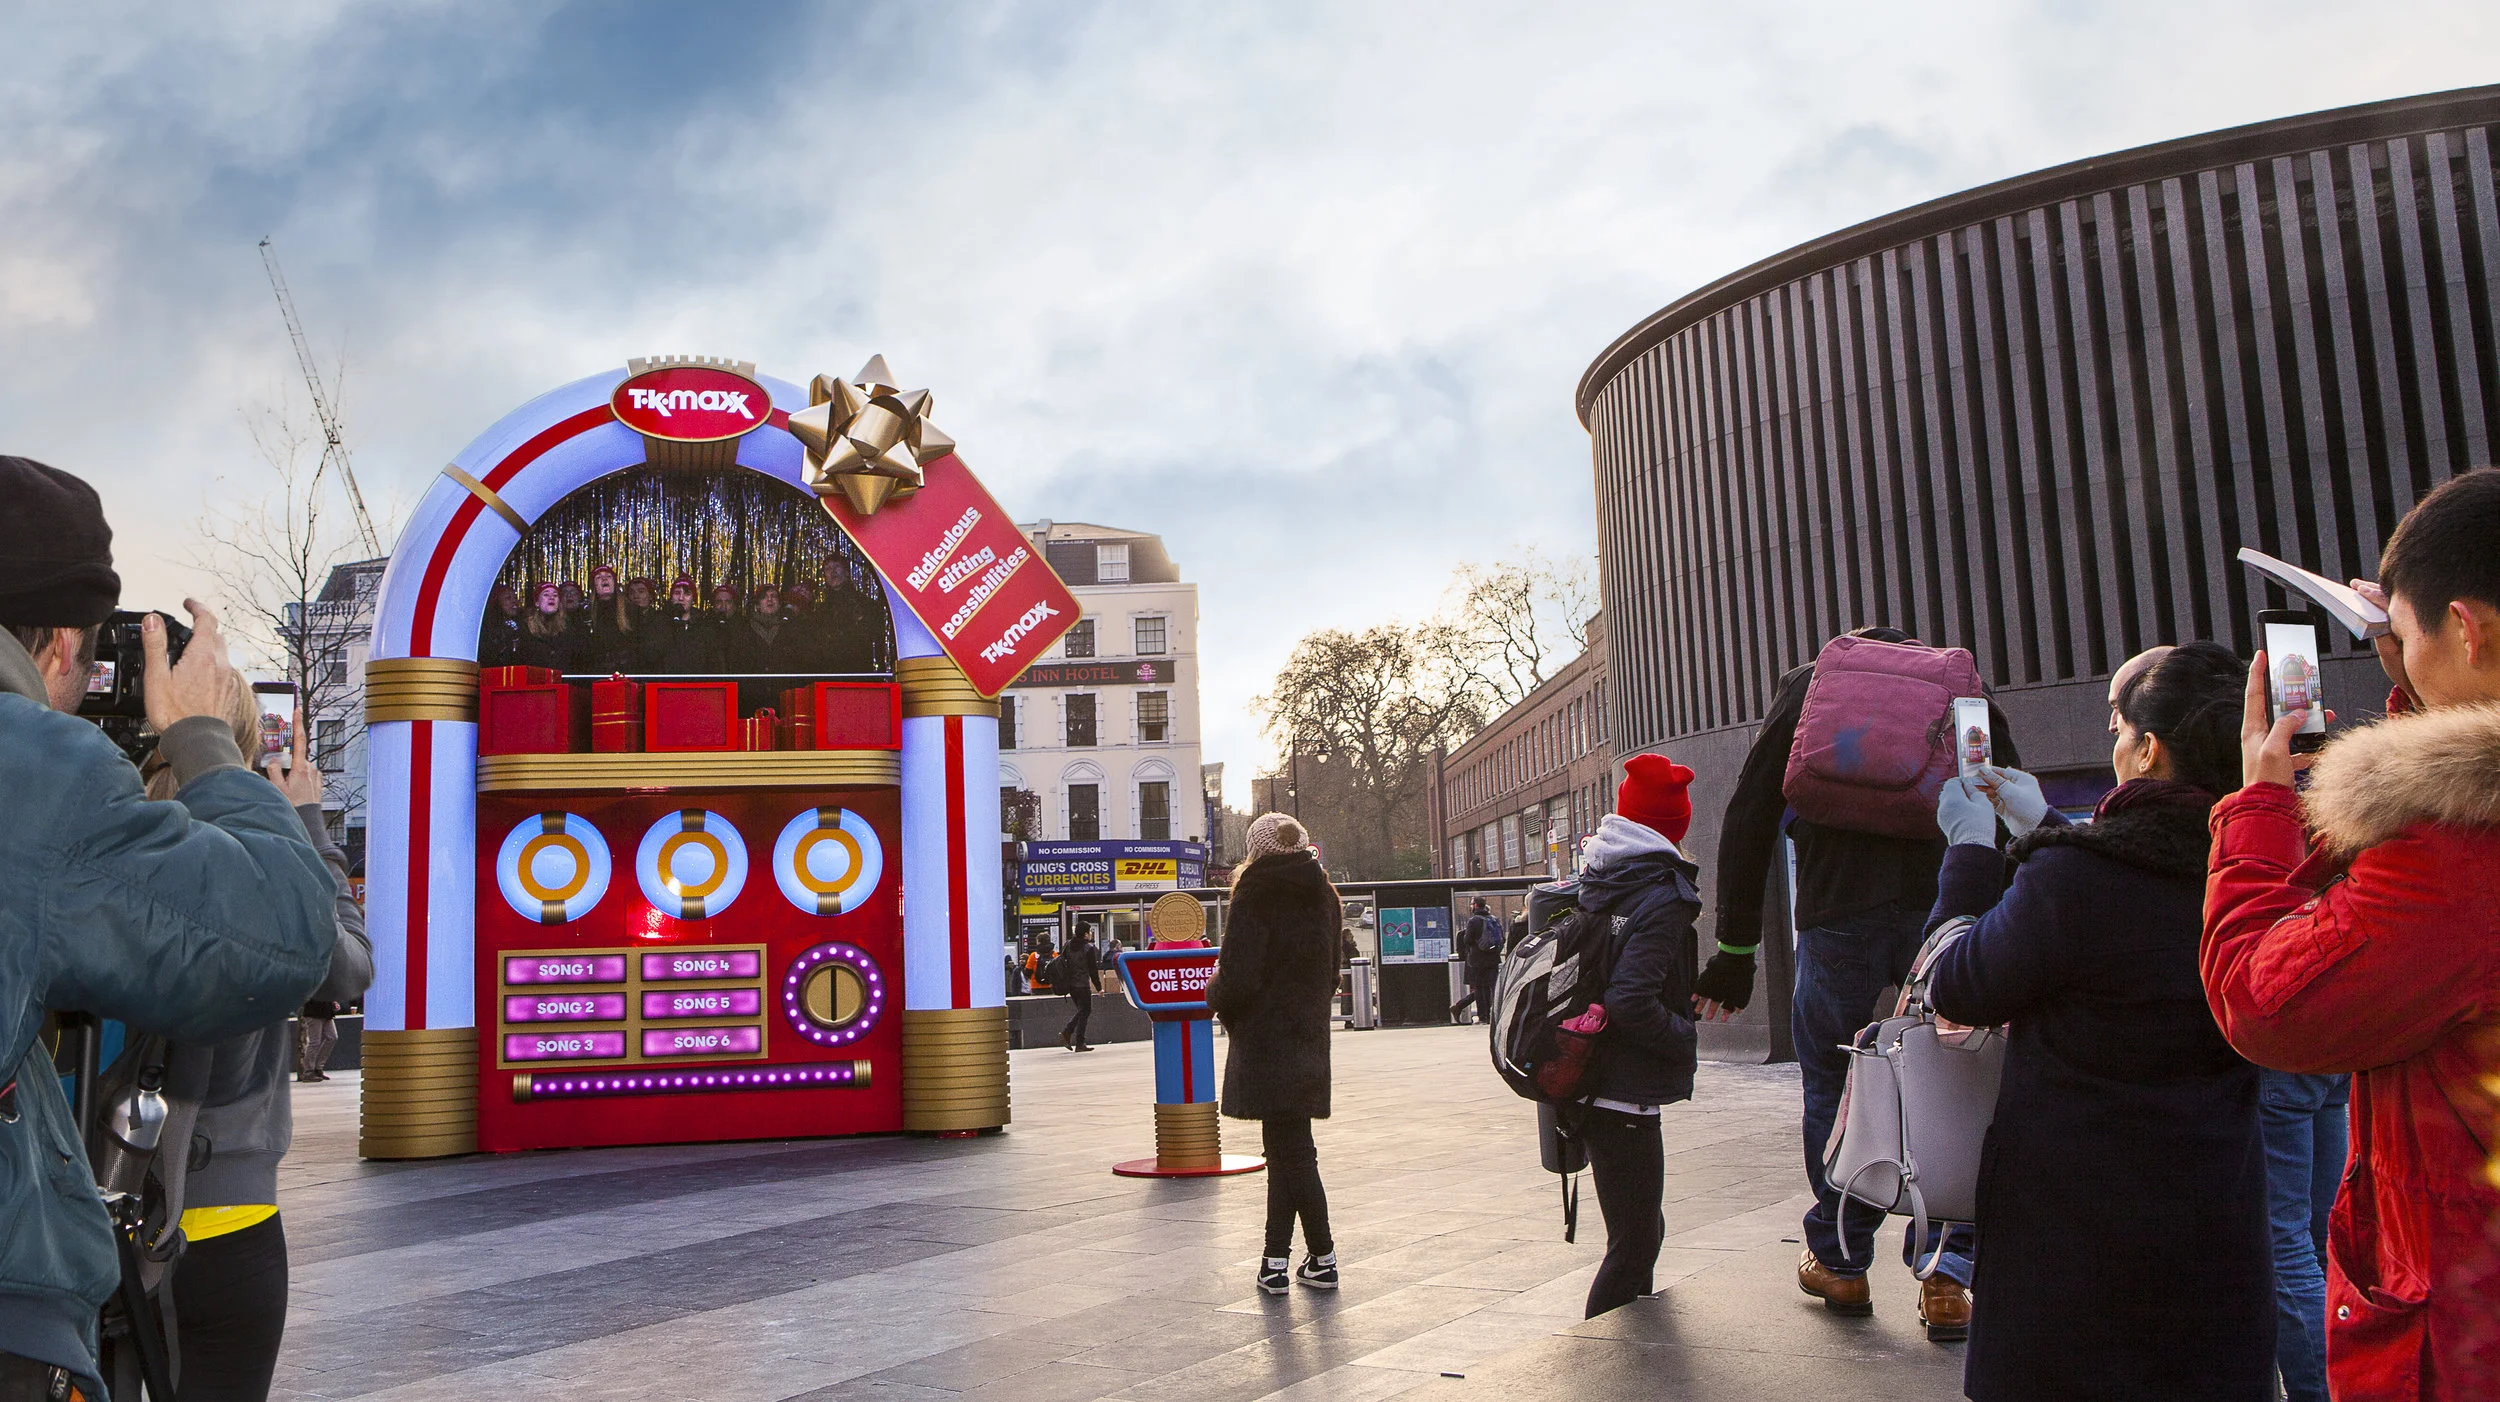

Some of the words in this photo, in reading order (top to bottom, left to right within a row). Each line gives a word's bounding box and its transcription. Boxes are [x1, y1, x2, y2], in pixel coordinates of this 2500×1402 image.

[906, 506, 979, 590] Ridiculous
[937, 545, 996, 594] gifting
[940, 546, 1027, 640] possibilities
[1032, 669, 1060, 683] INN
[1065, 667, 1120, 681] HOTEL
[1027, 862, 1066, 873] KING'S
[1070, 861, 1109, 872] CROSS
[1124, 862, 1169, 875] DHL
[1025, 873, 1110, 886] CURRENCIES
[539, 963, 584, 976] SONG
[587, 963, 593, 975] 1
[673, 960, 717, 972] SONG
[720, 960, 730, 971] 4
[1147, 969, 1176, 981] ONE
[1150, 980, 1178, 992] ONE
[1181, 979, 1209, 991] SON
[537, 1002, 582, 1014] SONG
[585, 1001, 594, 1013] 2
[673, 997, 717, 1010] SONG
[720, 997, 730, 1008] 5
[536, 1040, 581, 1053] SONG
[584, 1039, 594, 1051] 3
[674, 1035, 718, 1048] SONG
[721, 1035, 731, 1046] 6
